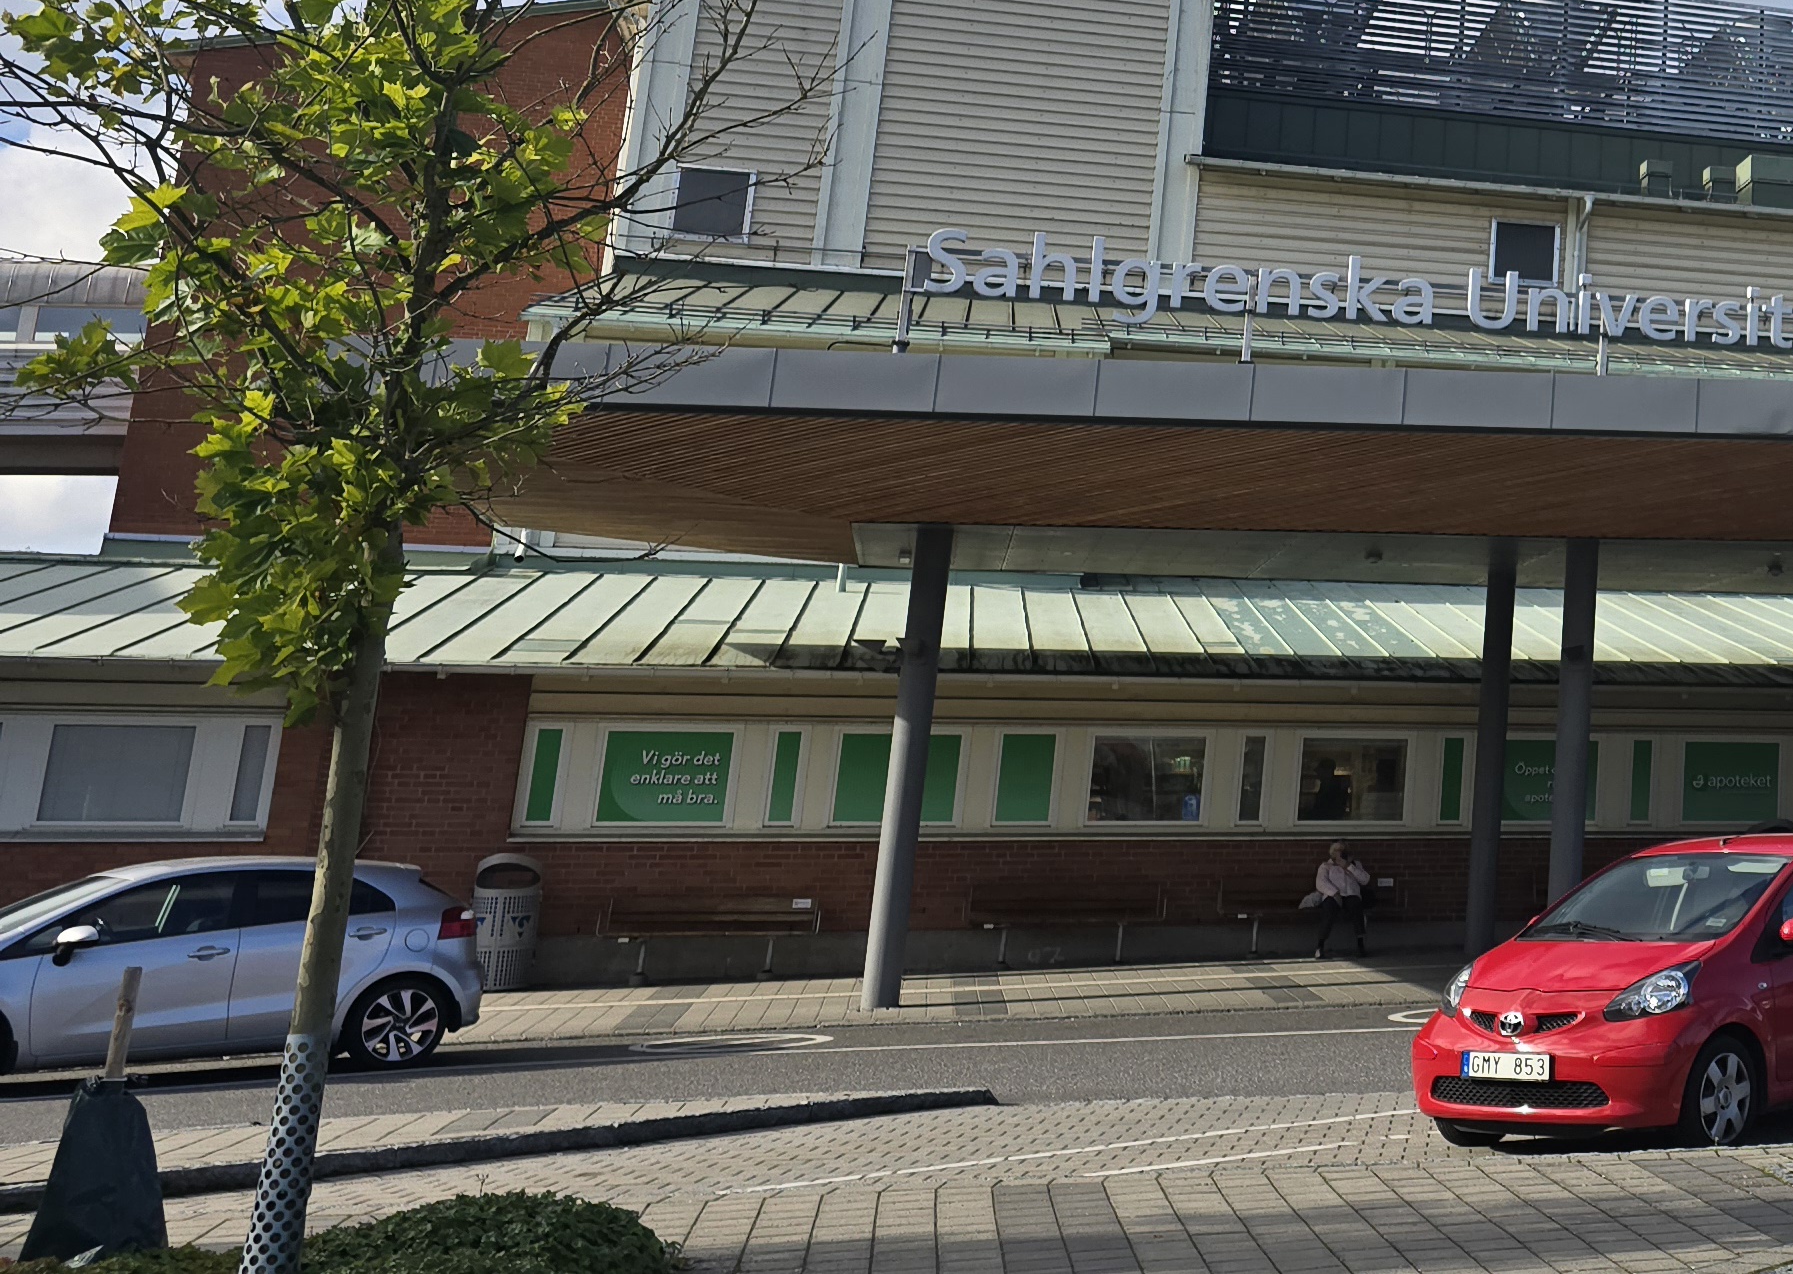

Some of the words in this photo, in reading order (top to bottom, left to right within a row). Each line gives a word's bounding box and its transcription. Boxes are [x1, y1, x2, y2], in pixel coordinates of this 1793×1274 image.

[923, 227, 1433, 325] Sahlgrenska
[642, 749, 659, 765] Vi
[660, 751, 691, 768] gör
[693, 750, 721, 766] det
[630, 769, 691, 785] enklare
[694, 771, 718, 785] att
[1514, 761, 1549, 776] Öppet
[1707, 773, 1771, 790] apoteket
[657, 789, 683, 804] må
[686, 788, 718, 804] bra.
[1471, 1055, 1501, 1075] GMY
[1513, 1057, 1545, 1076] 853
